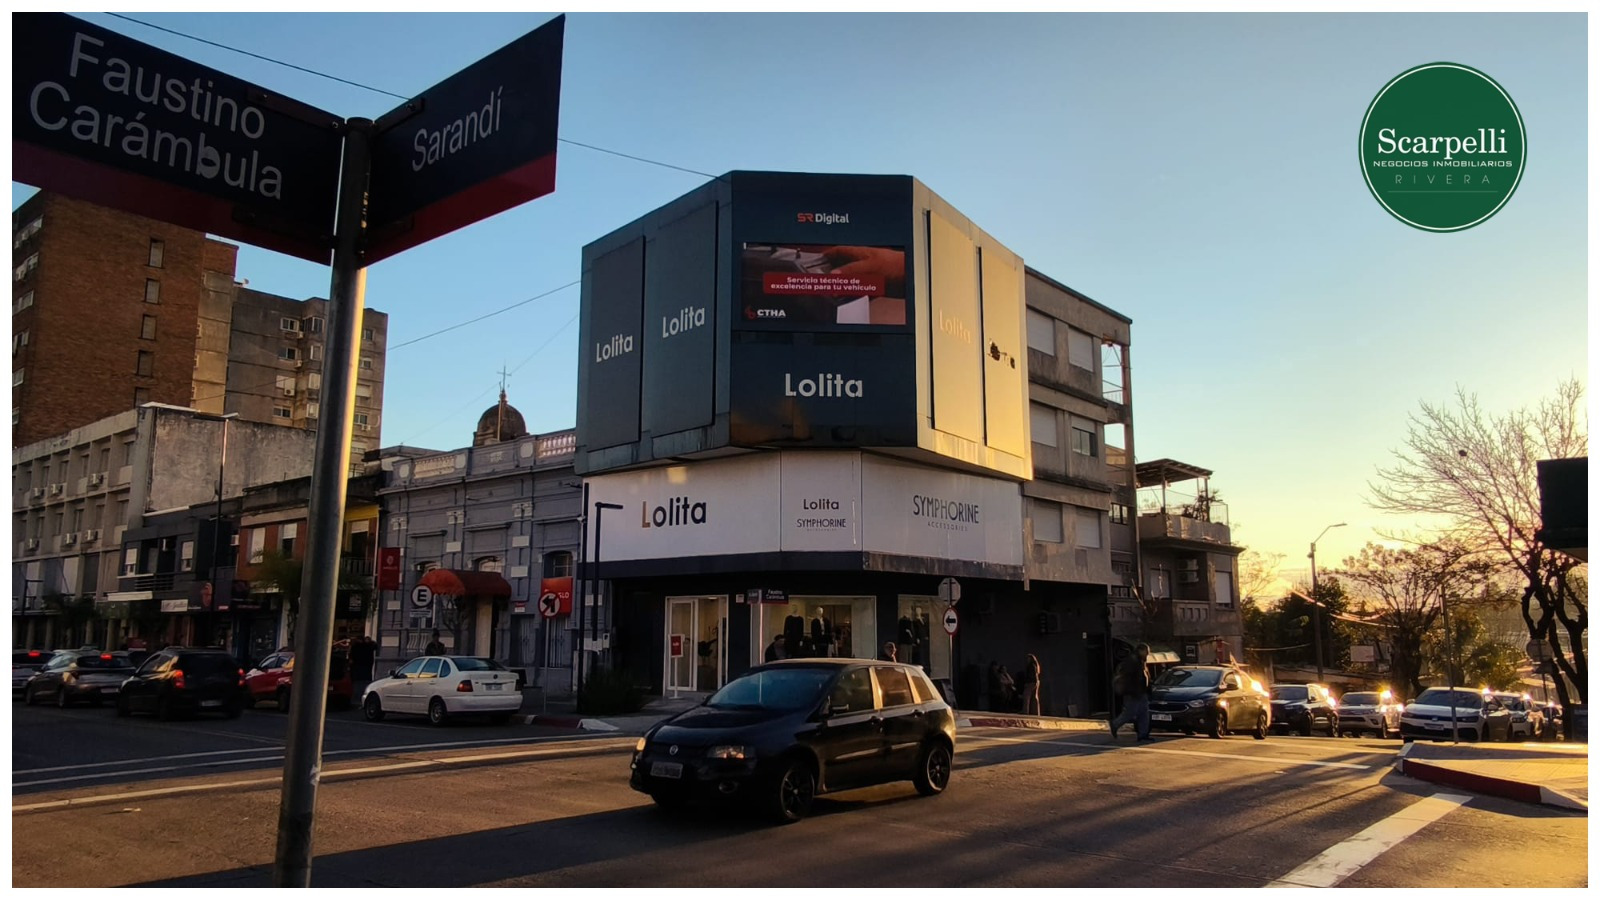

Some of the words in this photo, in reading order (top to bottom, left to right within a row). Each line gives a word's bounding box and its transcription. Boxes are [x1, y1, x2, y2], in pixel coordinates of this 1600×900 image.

[68, 32, 265, 140] Faustino
[30, 81, 283, 200] Carámbula
[411, 85, 504, 172] Sarandí
[815, 212, 850, 225] Digital
[786, 276, 818, 284] Servicio
[662, 306, 705, 339] Lolita
[757, 309, 786, 317] CTHA
[939, 308, 972, 344] Lolita
[596, 333, 633, 363] Lolita
[785, 373, 863, 398] Lolita
[642, 496, 707, 528] Lolita
[803, 498, 840, 510] Lolita
[912, 494, 979, 524] SYMPHORINE
[797, 518, 847, 528] SYMPHORINE
[417, 589, 427, 602] E
